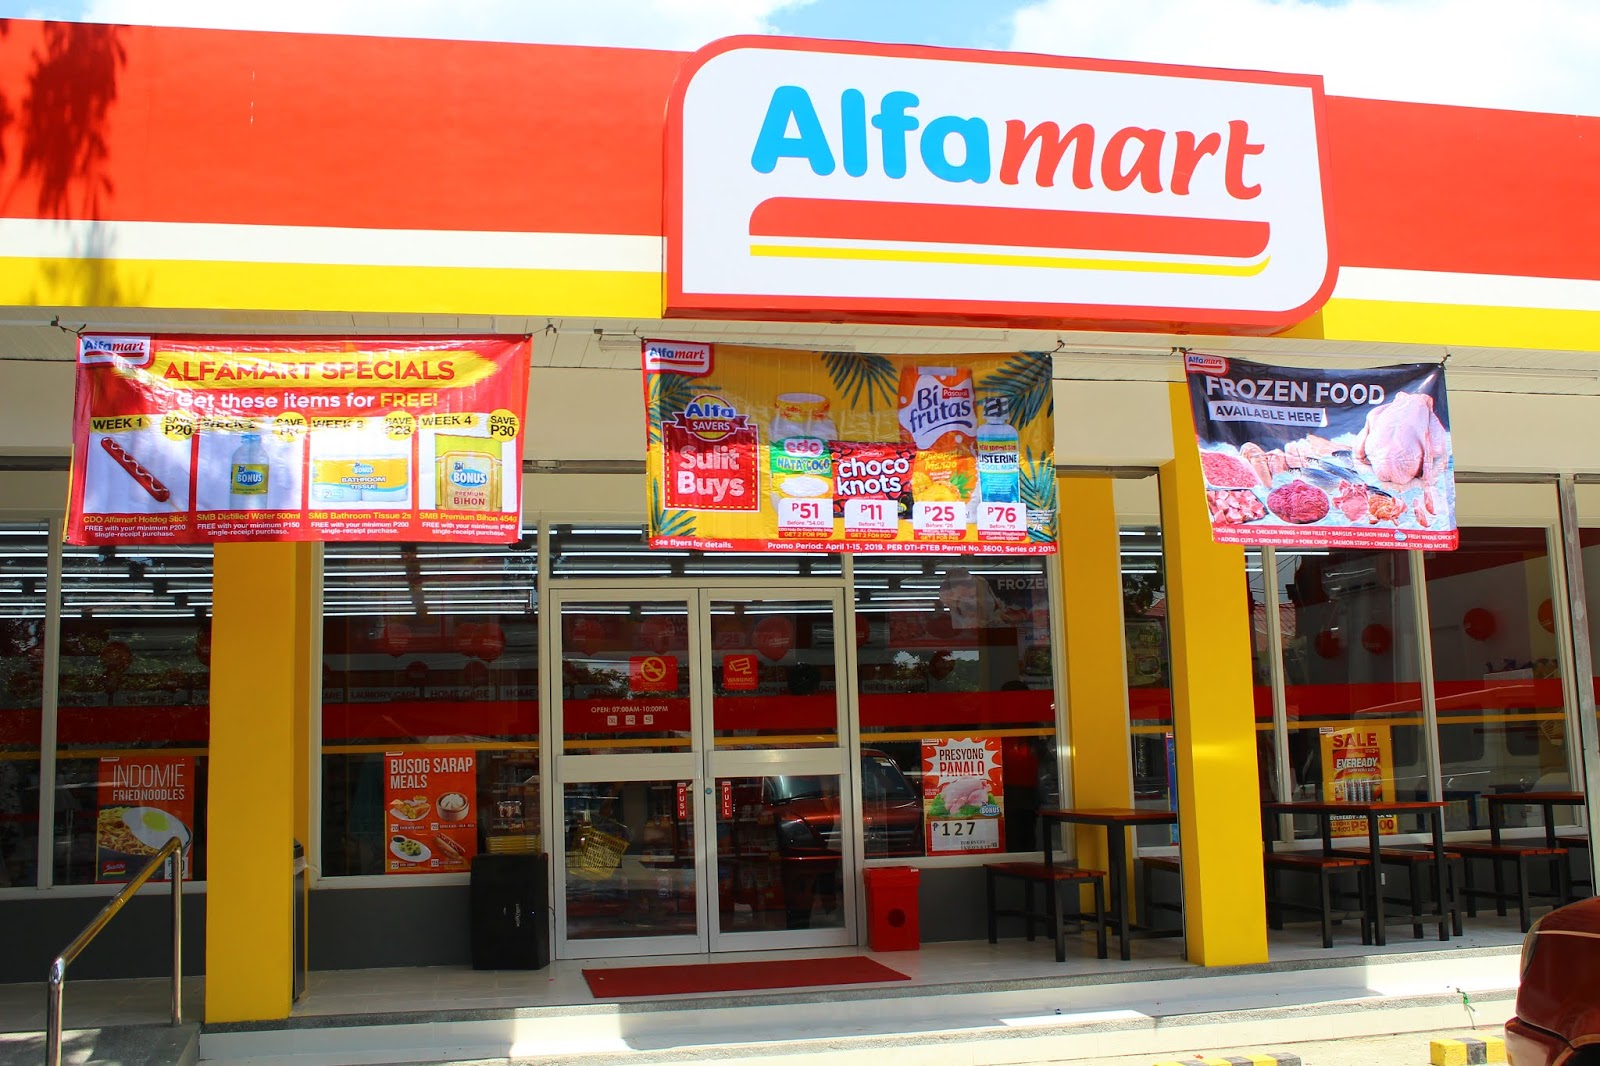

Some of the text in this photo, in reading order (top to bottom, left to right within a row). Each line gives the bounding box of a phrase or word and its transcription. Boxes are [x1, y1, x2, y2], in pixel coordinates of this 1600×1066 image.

[751, 85, 1265, 199] Alfamart
[84, 340, 144, 352] Alfamart
[650, 348, 705, 360] Alfamart
[1188, 356, 1223, 366] Alfamart
[163, 360, 455, 381] ALFAMART SPECIALS
[943, 389, 968, 397] Pascual
[1206, 376, 1385, 405] FROZEN FOOD
[176, 392, 438, 409] Get these items for FREE!
[685, 403, 736, 419] Alfa
[910, 400, 971, 433] frutas
[1216, 405, 1322, 422] AVAILABLE HERE
[93, 418, 142, 430] WEEK 1
[386, 418, 412, 426] SAVE
[422, 415, 472, 426] WEEK 4
[490, 416, 516, 424] SAVE
[692, 420, 730, 430] SAVERS
[165, 424, 192, 436] P20
[490, 426, 514, 437] P30
[786, 440, 820, 454] cdo
[680, 444, 740, 470] Sulit
[979, 454, 1017, 464] LISTERINE
[778, 457, 803, 470] NATA
[838, 457, 910, 478] choco
[237, 474, 262, 482] BONUS
[454, 472, 488, 484] BONUS
[678, 470, 745, 502] Buys
[836, 474, 902, 496] knots
[454, 497, 485, 506] BIHON
[83, 516, 102, 524] CDO
[104, 516, 137, 524] Alfamart
[138, 516, 168, 524] Hotdog
[330, 512, 371, 520] Bathroom
[440, 512, 474, 520] Premium
[499, 514, 518, 523] 454g
[670, 538, 692, 547] flyers
[693, 540, 703, 548] for
[705, 540, 734, 548] details.
[982, 545, 1004, 553] 3600,
[997, 578, 1048, 590] FROZE
[430, 689, 490, 698] HOME CARE
[1332, 732, 1378, 748] SALE
[939, 748, 984, 761] PRESYONG
[390, 757, 474, 774] BUSOG SARAP
[940, 760, 985, 778] PANALO
[1336, 758, 1378, 769] EVEREADY
[113, 764, 185, 788] INDOMIE
[390, 774, 428, 789] MEALS
